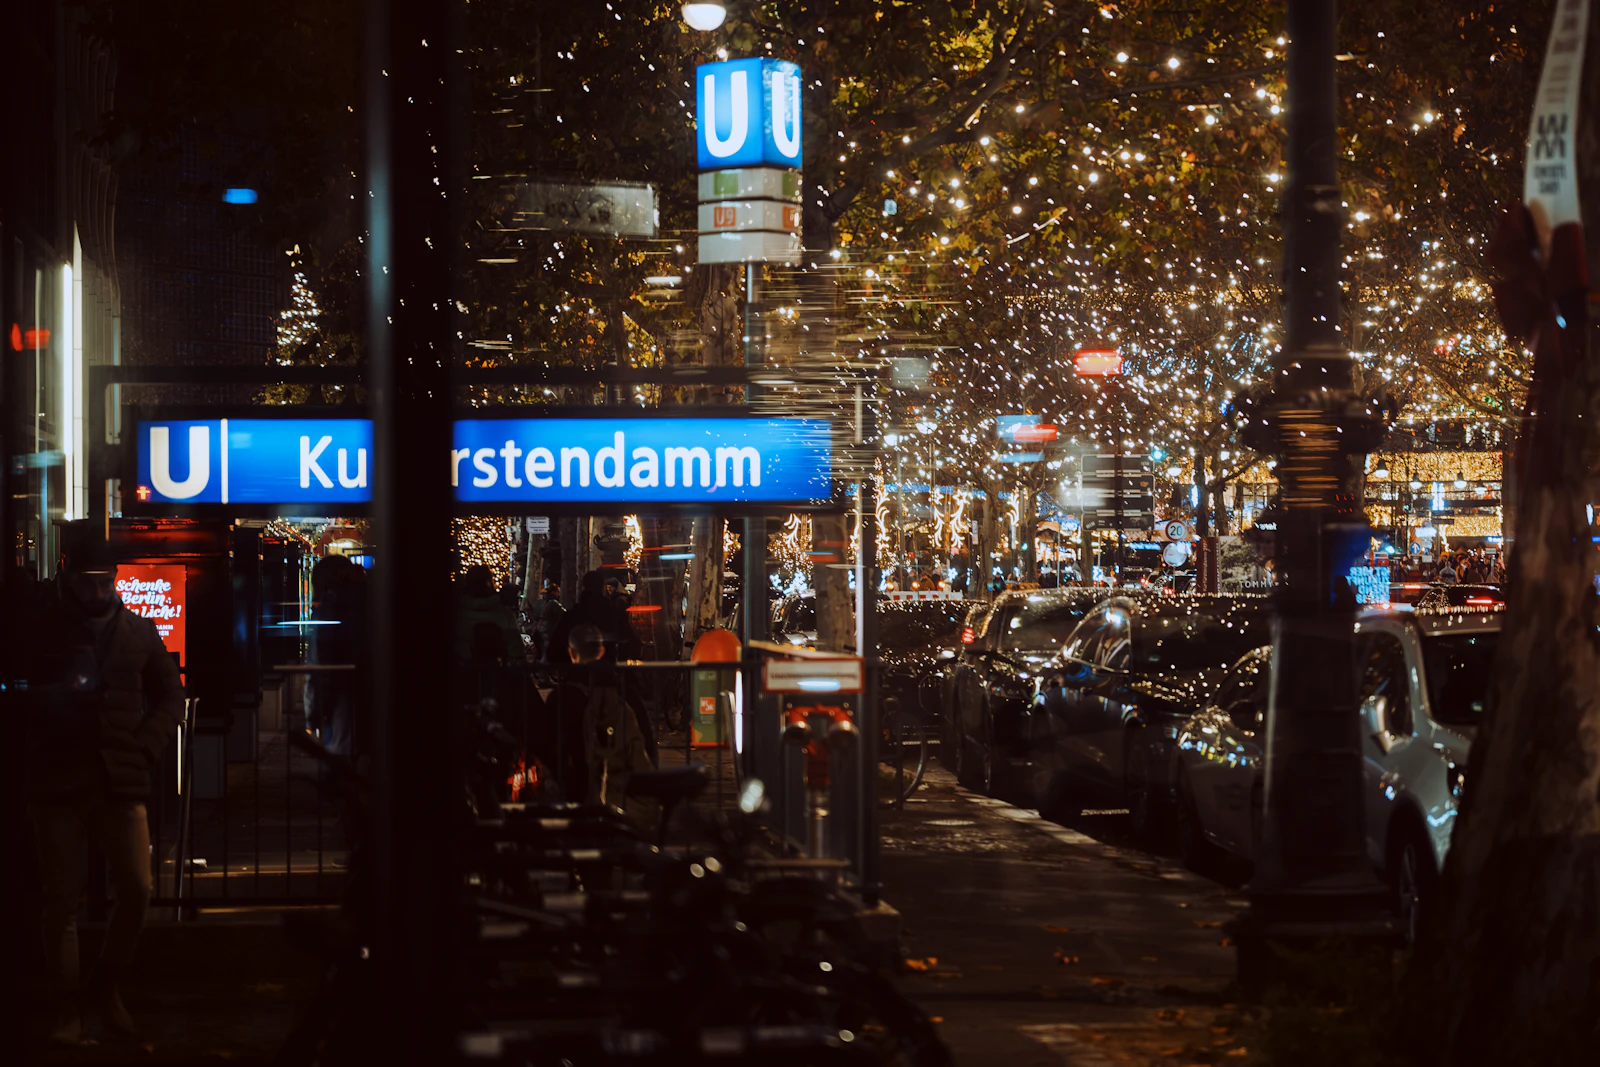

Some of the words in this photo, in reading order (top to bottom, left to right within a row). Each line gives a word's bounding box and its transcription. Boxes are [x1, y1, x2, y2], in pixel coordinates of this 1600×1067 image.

[704, 70, 748, 158] U
[771, 71, 799, 158] U
[715, 207, 735, 226] U9
[150, 426, 209, 499] U
[300, 431, 762, 488] Kurstendamm
[1170, 525, 1183, 536] 20
[115, 578, 171, 593] Schenke
[1240, 580, 1273, 588] TOMMY
[121, 591, 166, 606] Berlin
[141, 605, 182, 620] Licht!
